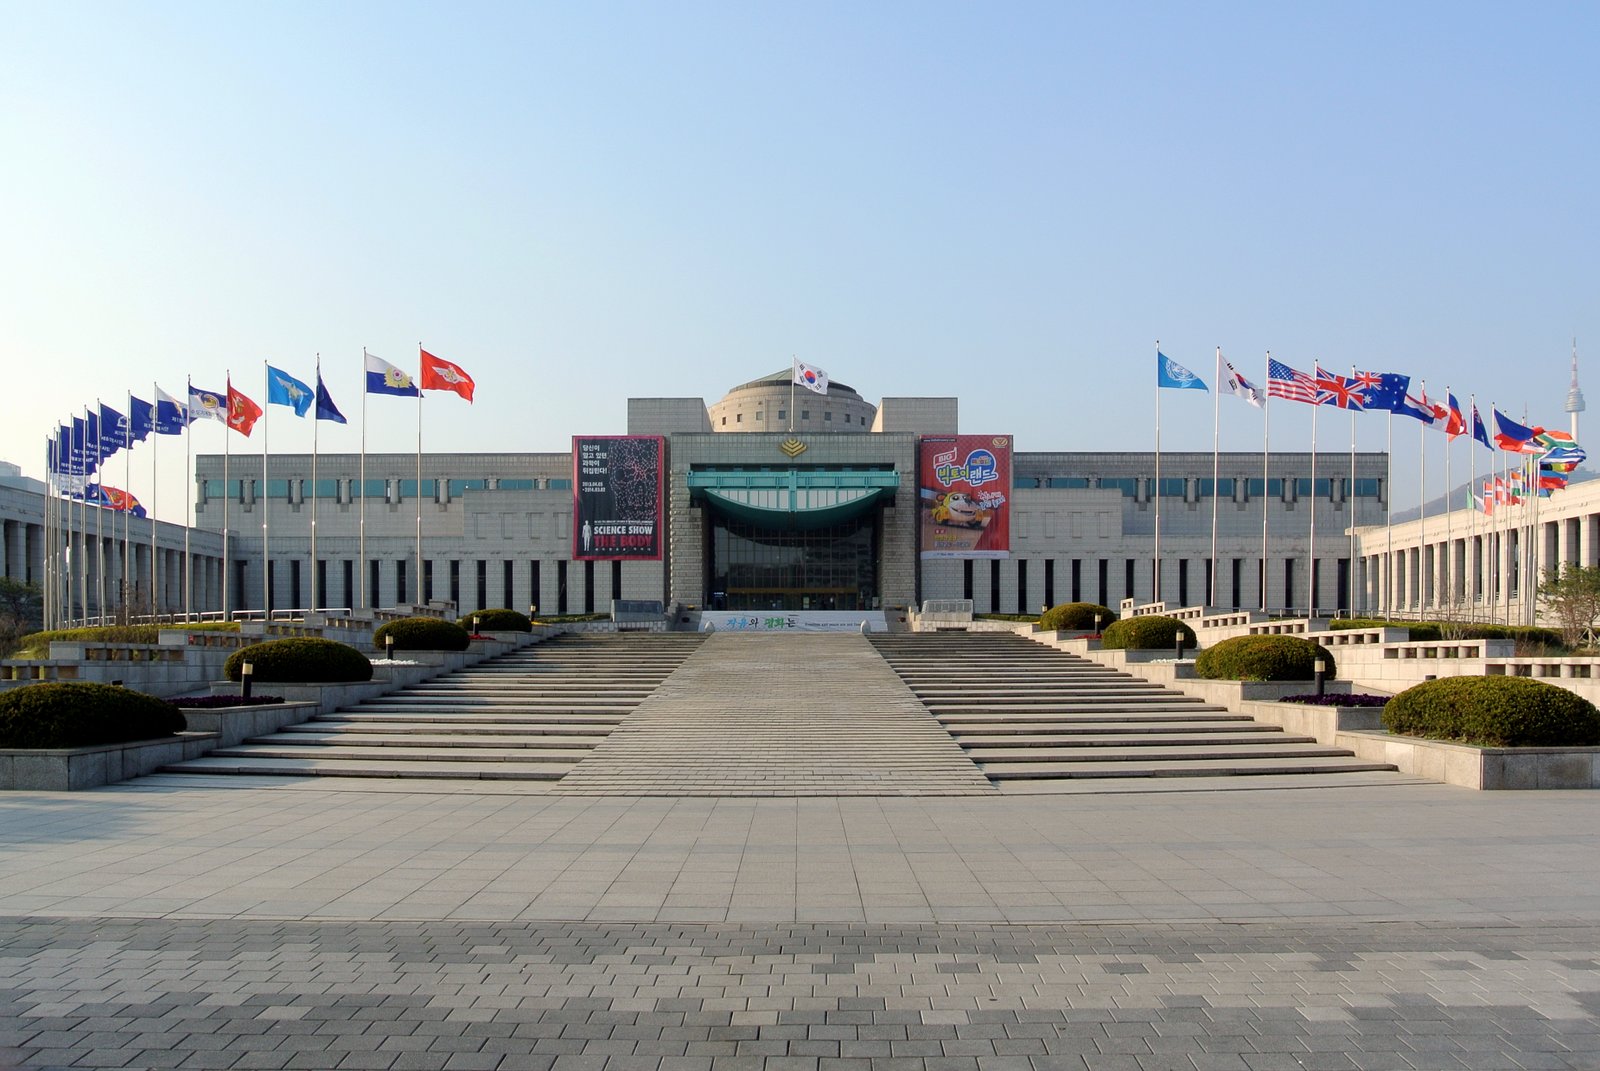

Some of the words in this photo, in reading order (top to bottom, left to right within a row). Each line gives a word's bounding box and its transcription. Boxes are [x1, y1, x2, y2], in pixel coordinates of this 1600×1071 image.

[938, 453, 953, 463] BIG
[938, 465, 996, 485] 빅토이랜드
[593, 525, 627, 535] SCIENCE
[628, 525, 653, 535] SHOW
[593, 535, 617, 547] THE
[620, 535, 653, 547] BODY
[726, 617, 759, 628] 자유와
